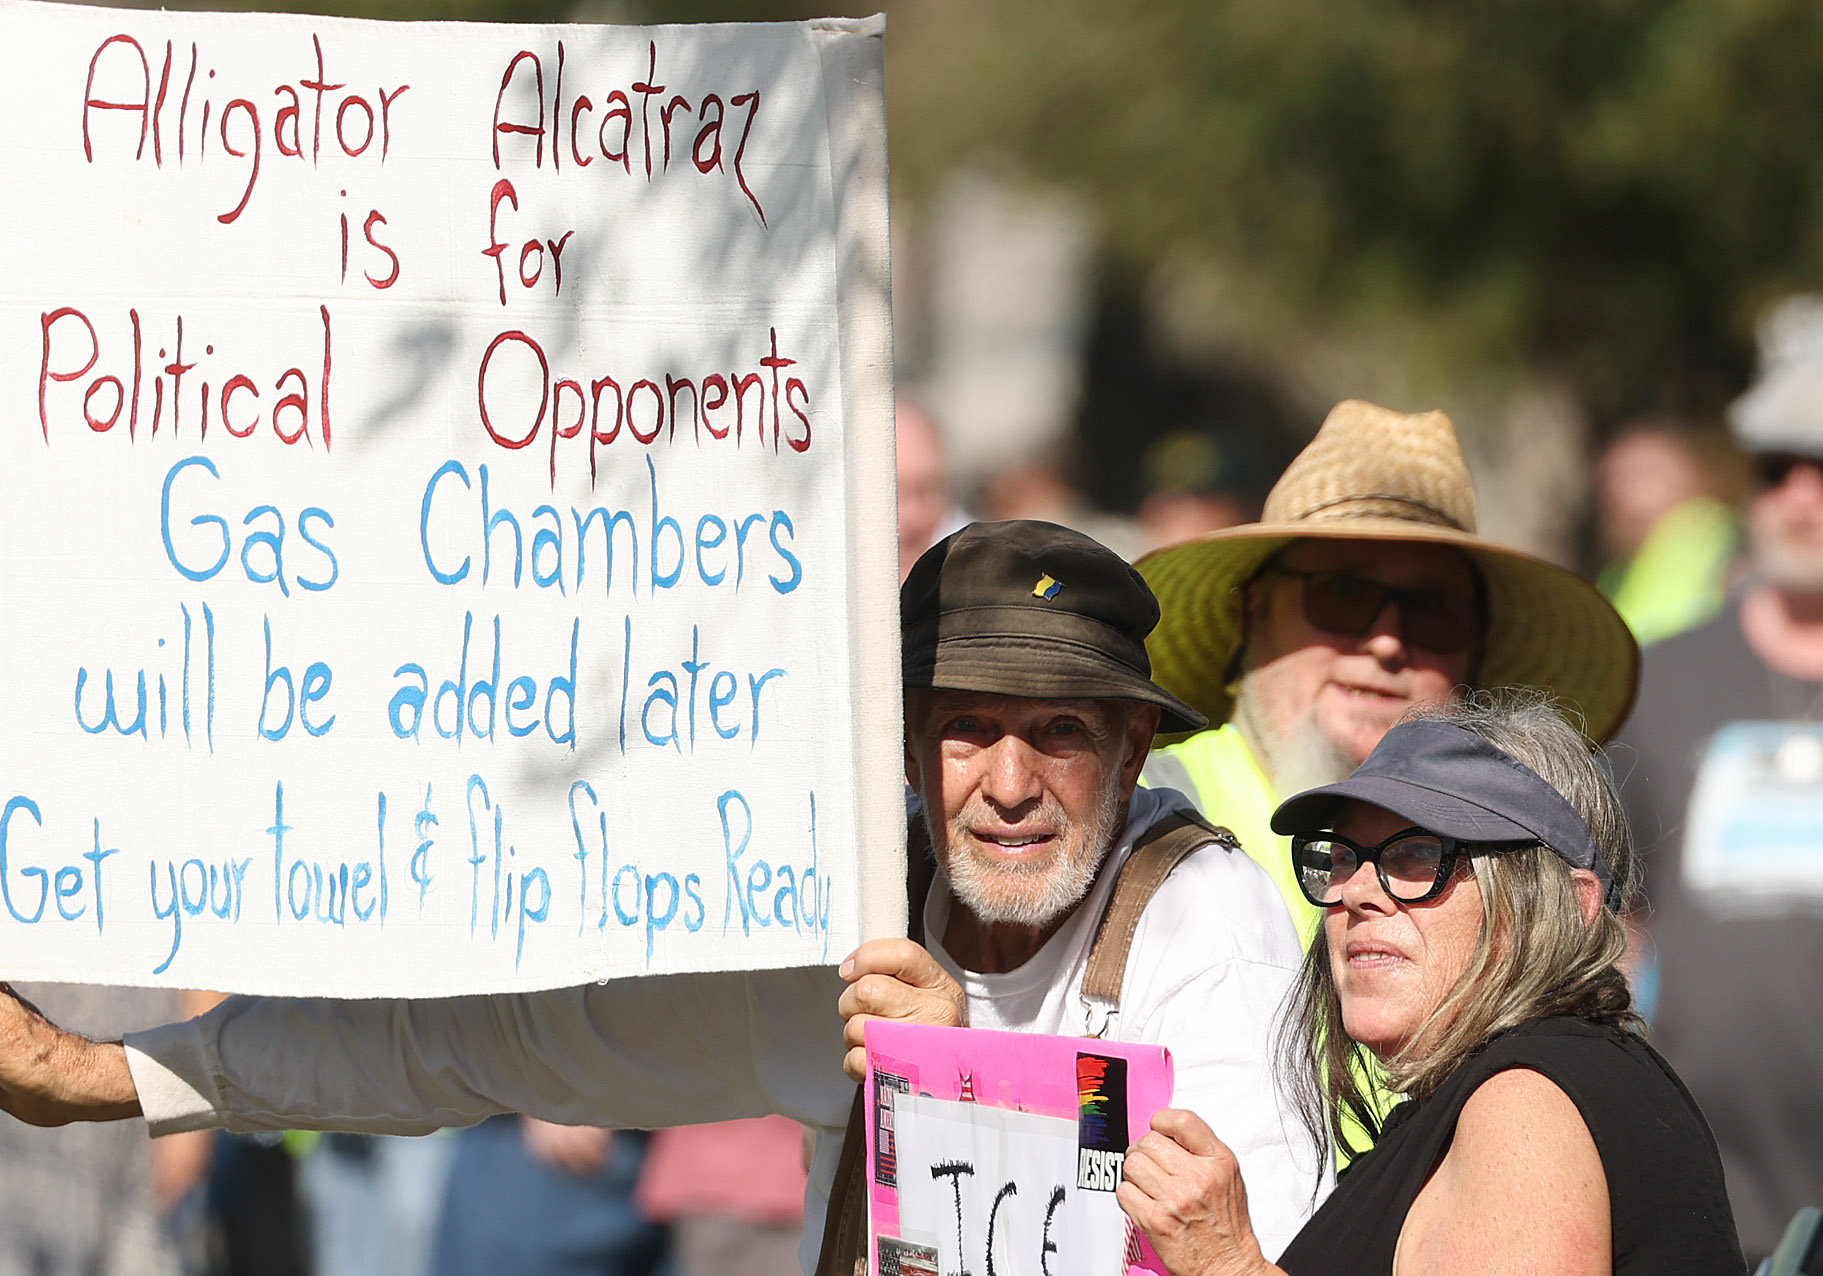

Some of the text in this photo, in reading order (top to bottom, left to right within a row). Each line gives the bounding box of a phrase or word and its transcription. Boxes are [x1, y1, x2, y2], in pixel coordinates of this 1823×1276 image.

[82, 33, 769, 228] Alligator Alcatraz
[340, 178, 575, 306] is for
[39, 305, 812, 493] Political Opponents
[161, 453, 803, 597] Gas Chambers
[75, 602, 788, 755] will be added later
[0, 773, 832, 974] Get your towel & flip flops Ready
[1078, 1147, 1125, 1191] RESIST
